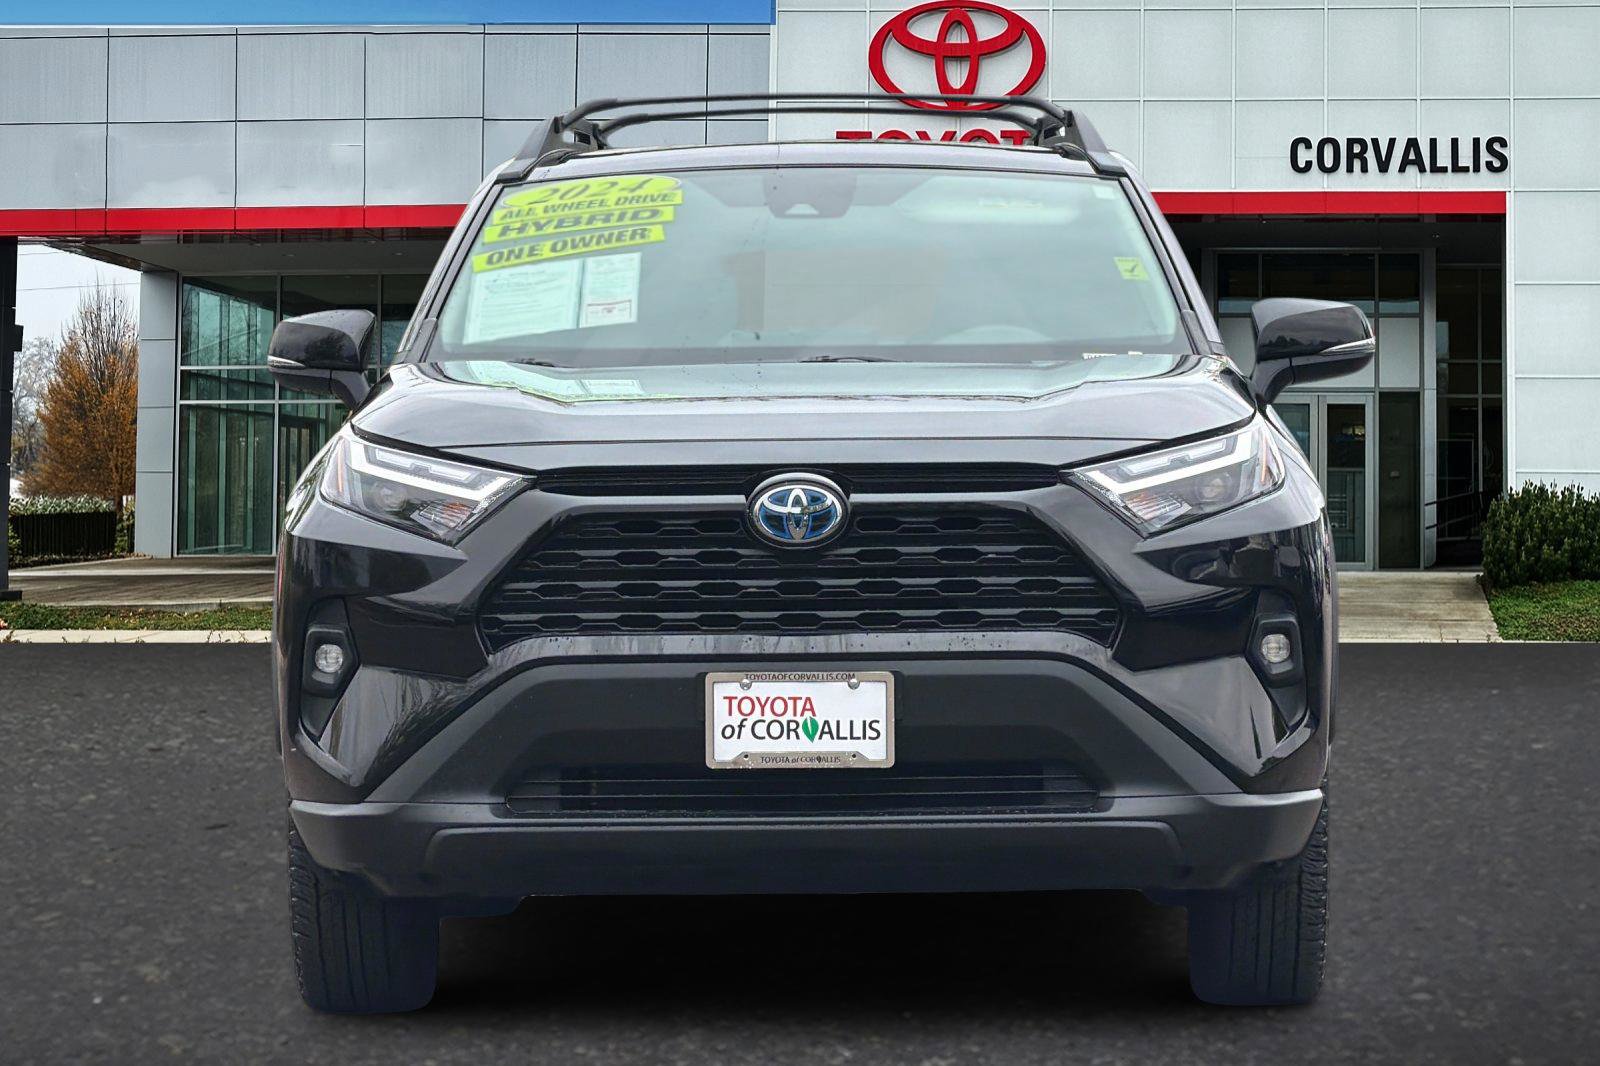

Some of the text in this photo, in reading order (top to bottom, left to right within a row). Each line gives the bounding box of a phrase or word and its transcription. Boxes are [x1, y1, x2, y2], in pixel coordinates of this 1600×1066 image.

[1289, 137, 1509, 174] CORVALLIS
[528, 178, 653, 205] 2024
[500, 192, 675, 221] ALL WHEEL DRIVE
[498, 209, 661, 237] HYBRID
[486, 227, 652, 266] ONE OWNER
[723, 696, 817, 717] TOYOTA
[721, 718, 747, 740] of
[761, 756, 790, 764] TOYOTA
[791, 756, 800, 764] of
